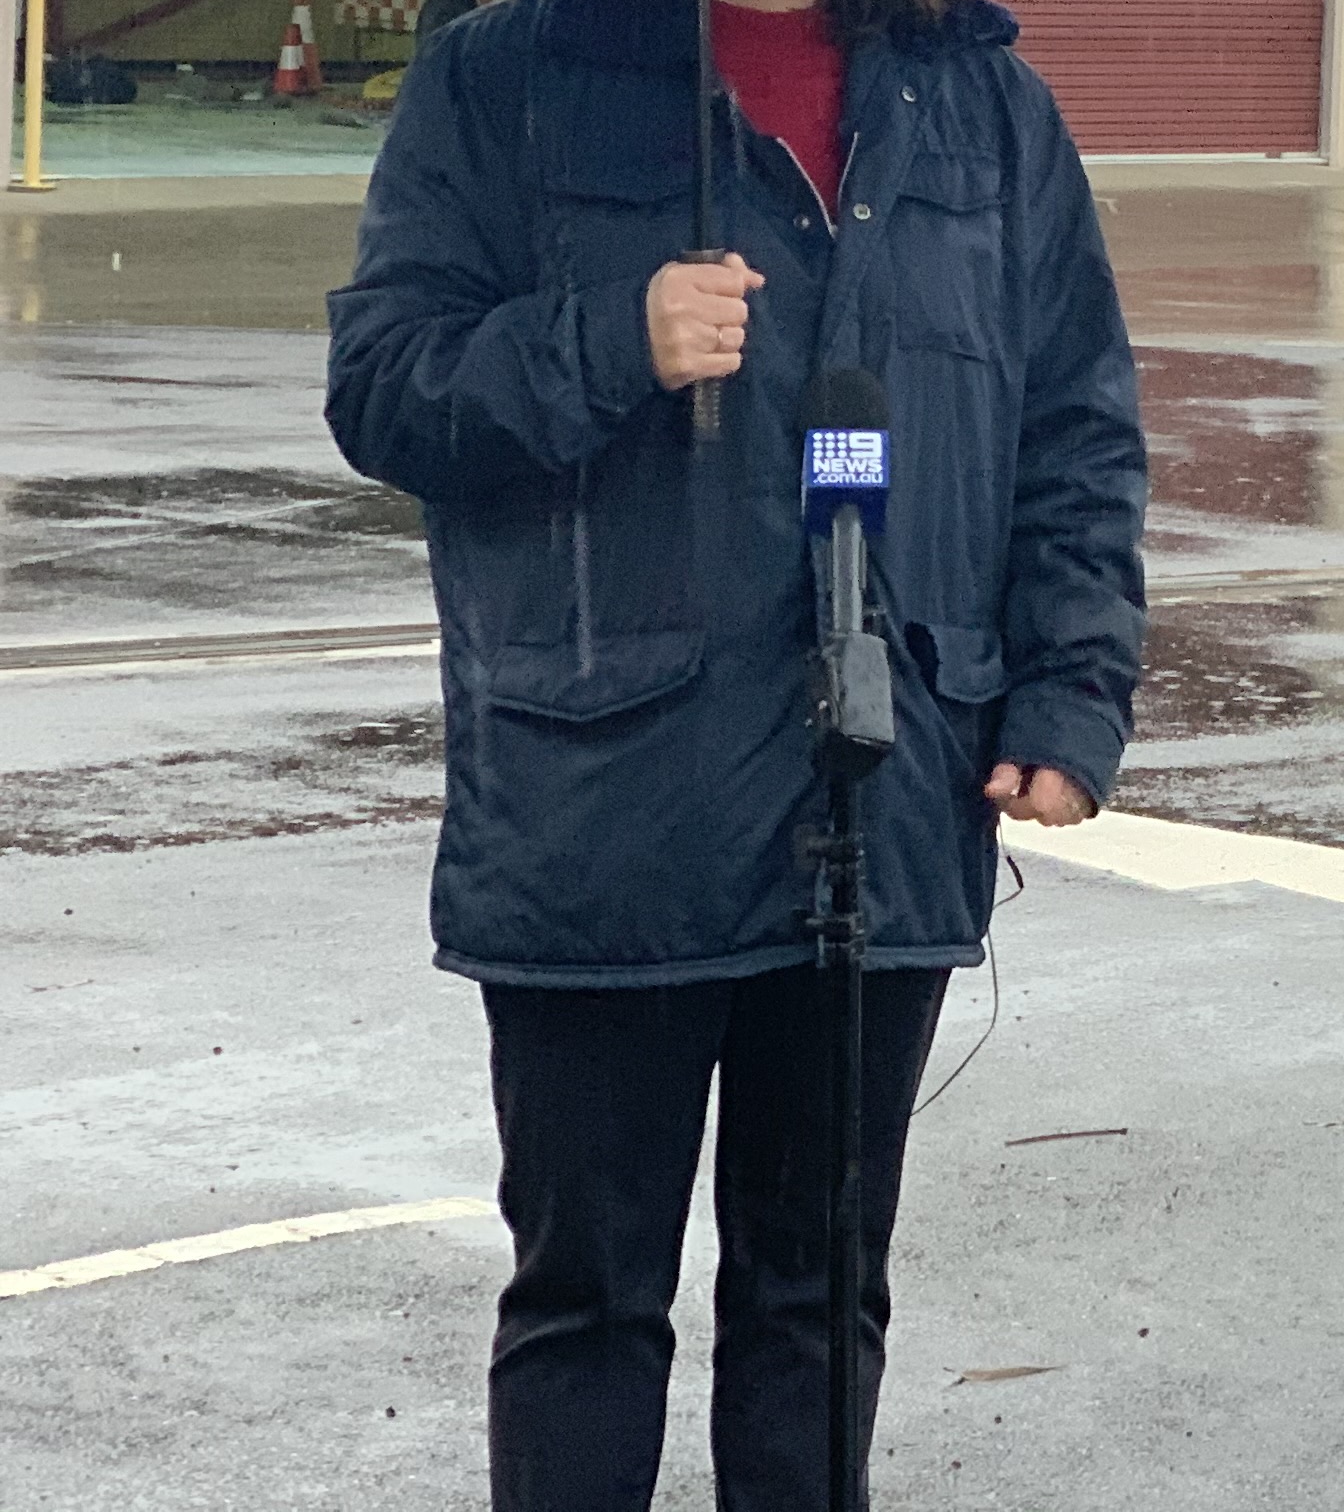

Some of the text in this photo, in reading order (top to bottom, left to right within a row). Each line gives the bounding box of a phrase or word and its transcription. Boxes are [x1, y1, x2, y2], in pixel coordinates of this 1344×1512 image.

[849, 432, 883, 458] 9
[813, 458, 883, 473] NEWS
[813, 472, 884, 484] .com.au
